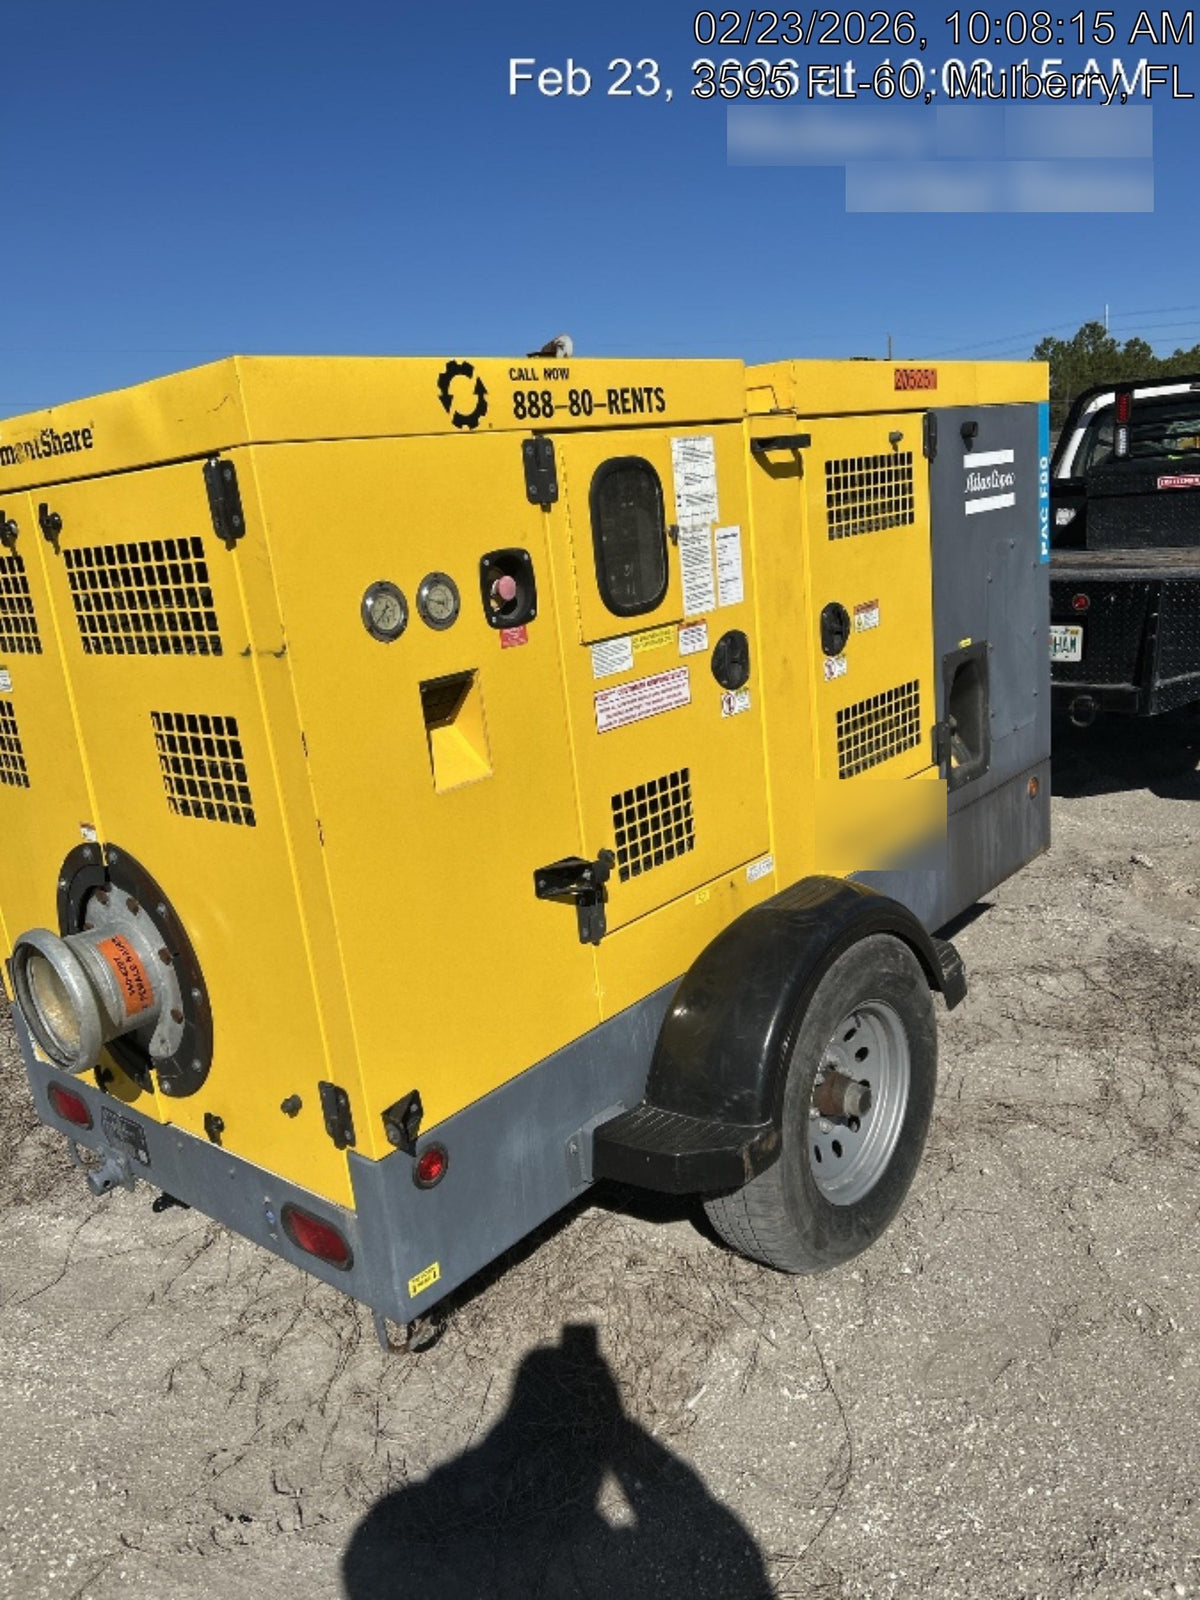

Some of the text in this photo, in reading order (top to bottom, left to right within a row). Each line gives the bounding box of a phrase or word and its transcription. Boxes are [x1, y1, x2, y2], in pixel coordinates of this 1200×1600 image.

[509, 367, 570, 381] CALL NOW
[512, 387, 666, 420] 888-80-RENTS
